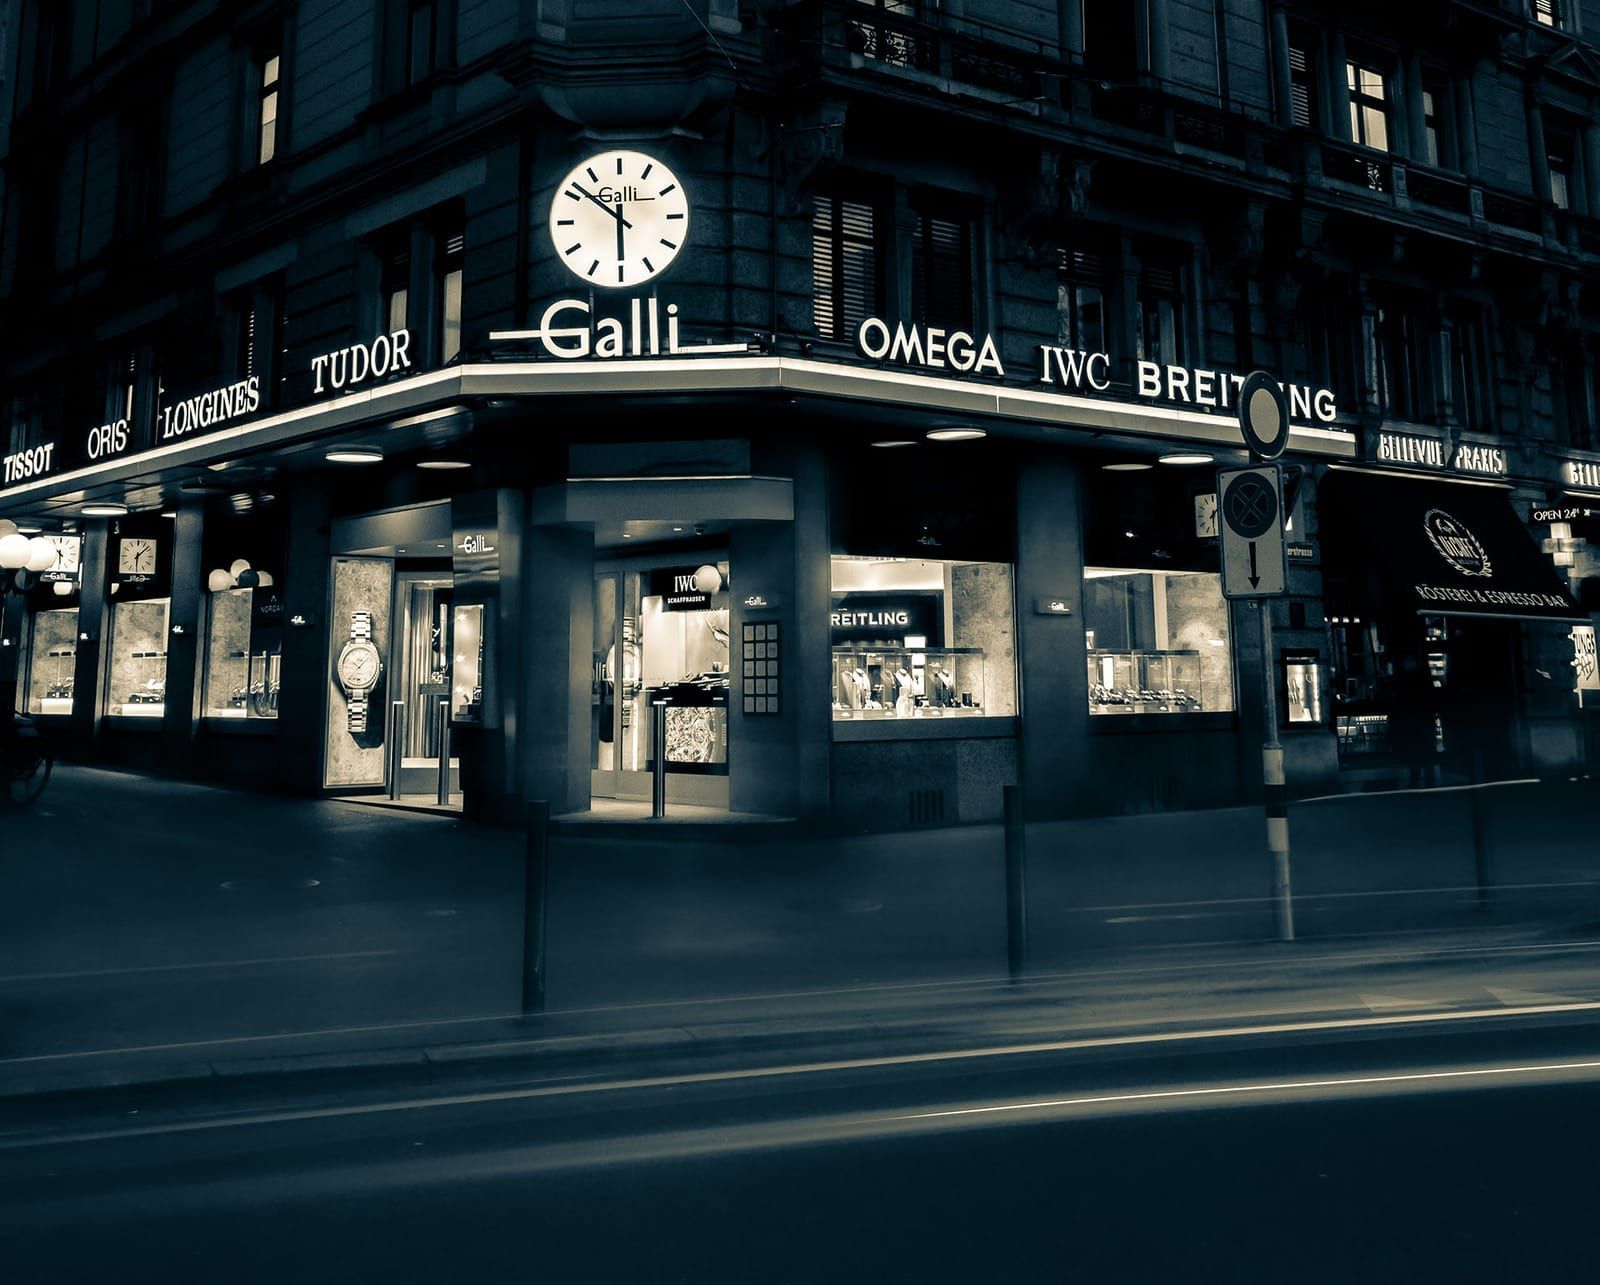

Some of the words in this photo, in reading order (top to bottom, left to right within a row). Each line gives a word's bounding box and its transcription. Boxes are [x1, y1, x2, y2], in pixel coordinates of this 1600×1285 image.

[585, 186, 655, 203] Galli
[489, 297, 748, 358] Galli
[859, 317, 1005, 376] OMEGA
[312, 328, 411, 394] TUDOR
[1040, 344, 1111, 391] IWC
[163, 375, 260, 439] LONGINES
[1137, 360, 1337, 422] BREITNG
[88, 418, 128, 459] ORIS
[1380, 434, 1445, 467] BELLEVUE
[1455, 444, 1503, 474] PRAXIS
[3, 442, 54, 483] TISSOT
[1533, 510, 1562, 521] OPEN
[457, 535, 494, 554] Galli
[667, 595, 706, 604] SCHAFFHAUSEN
[1415, 584, 1477, 602] RÖSTEREI
[1473, 590, 1488, 603] &
[1487, 590, 1544, 606] ESPRESSO
[1542, 594, 1569, 608] BAR
